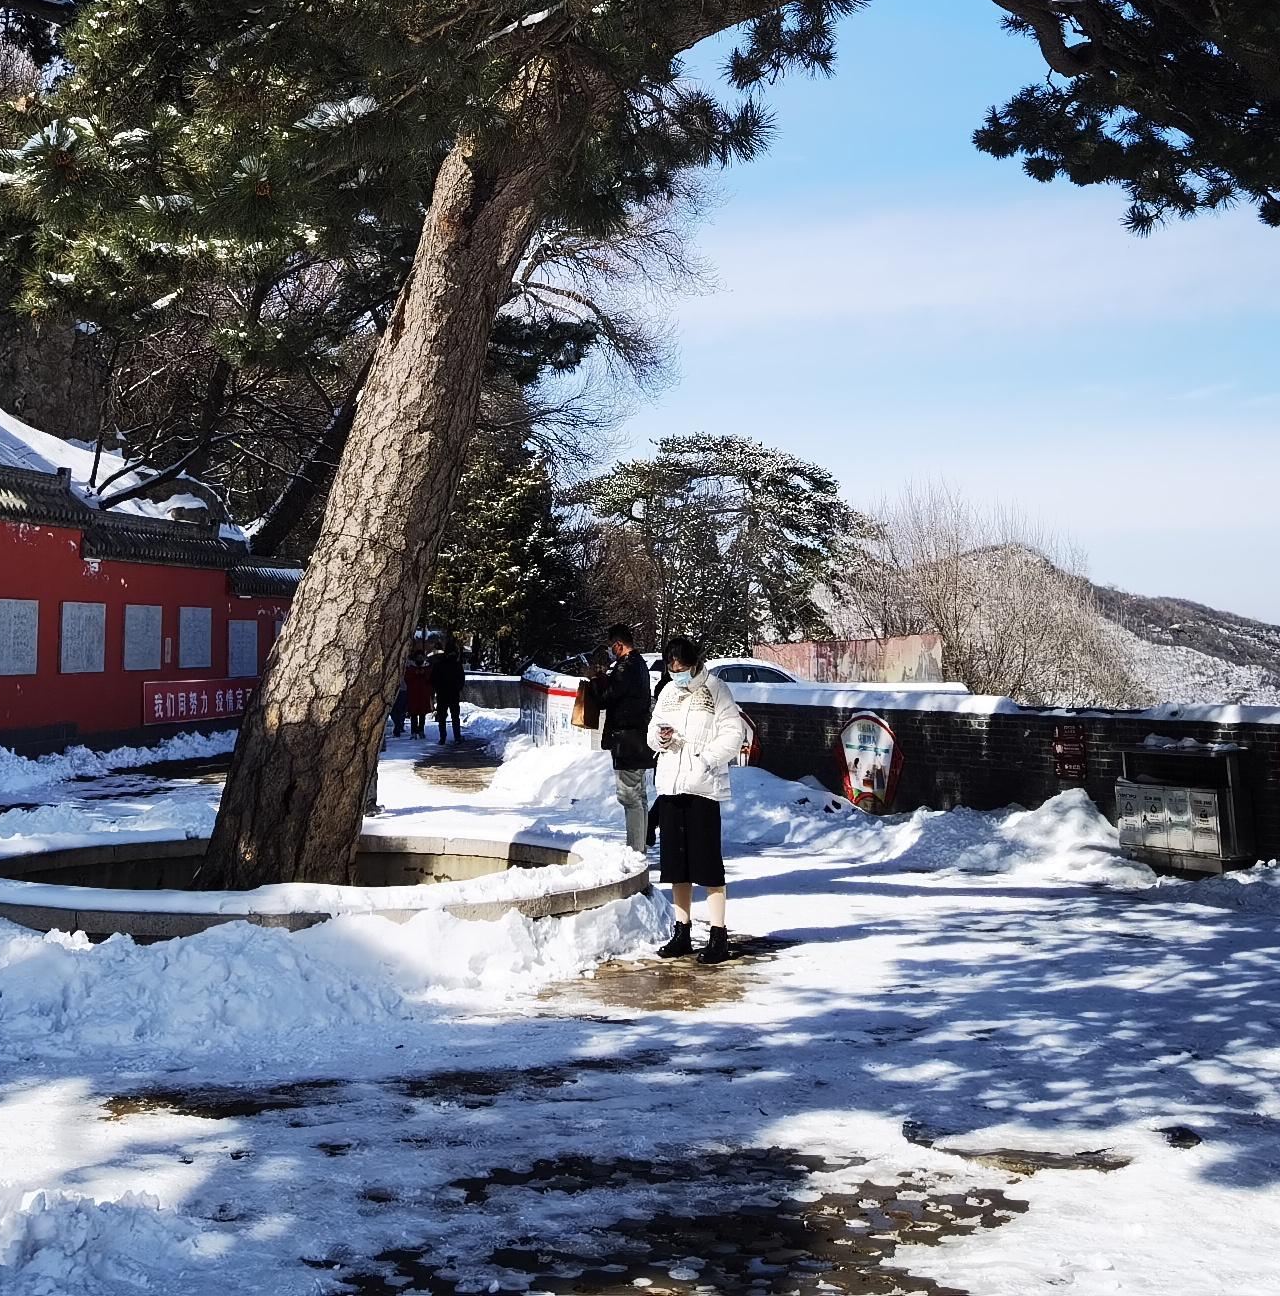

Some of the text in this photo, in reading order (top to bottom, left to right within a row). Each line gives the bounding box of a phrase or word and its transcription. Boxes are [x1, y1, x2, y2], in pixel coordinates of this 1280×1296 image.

[154, 690, 208, 718] 我们同努力
